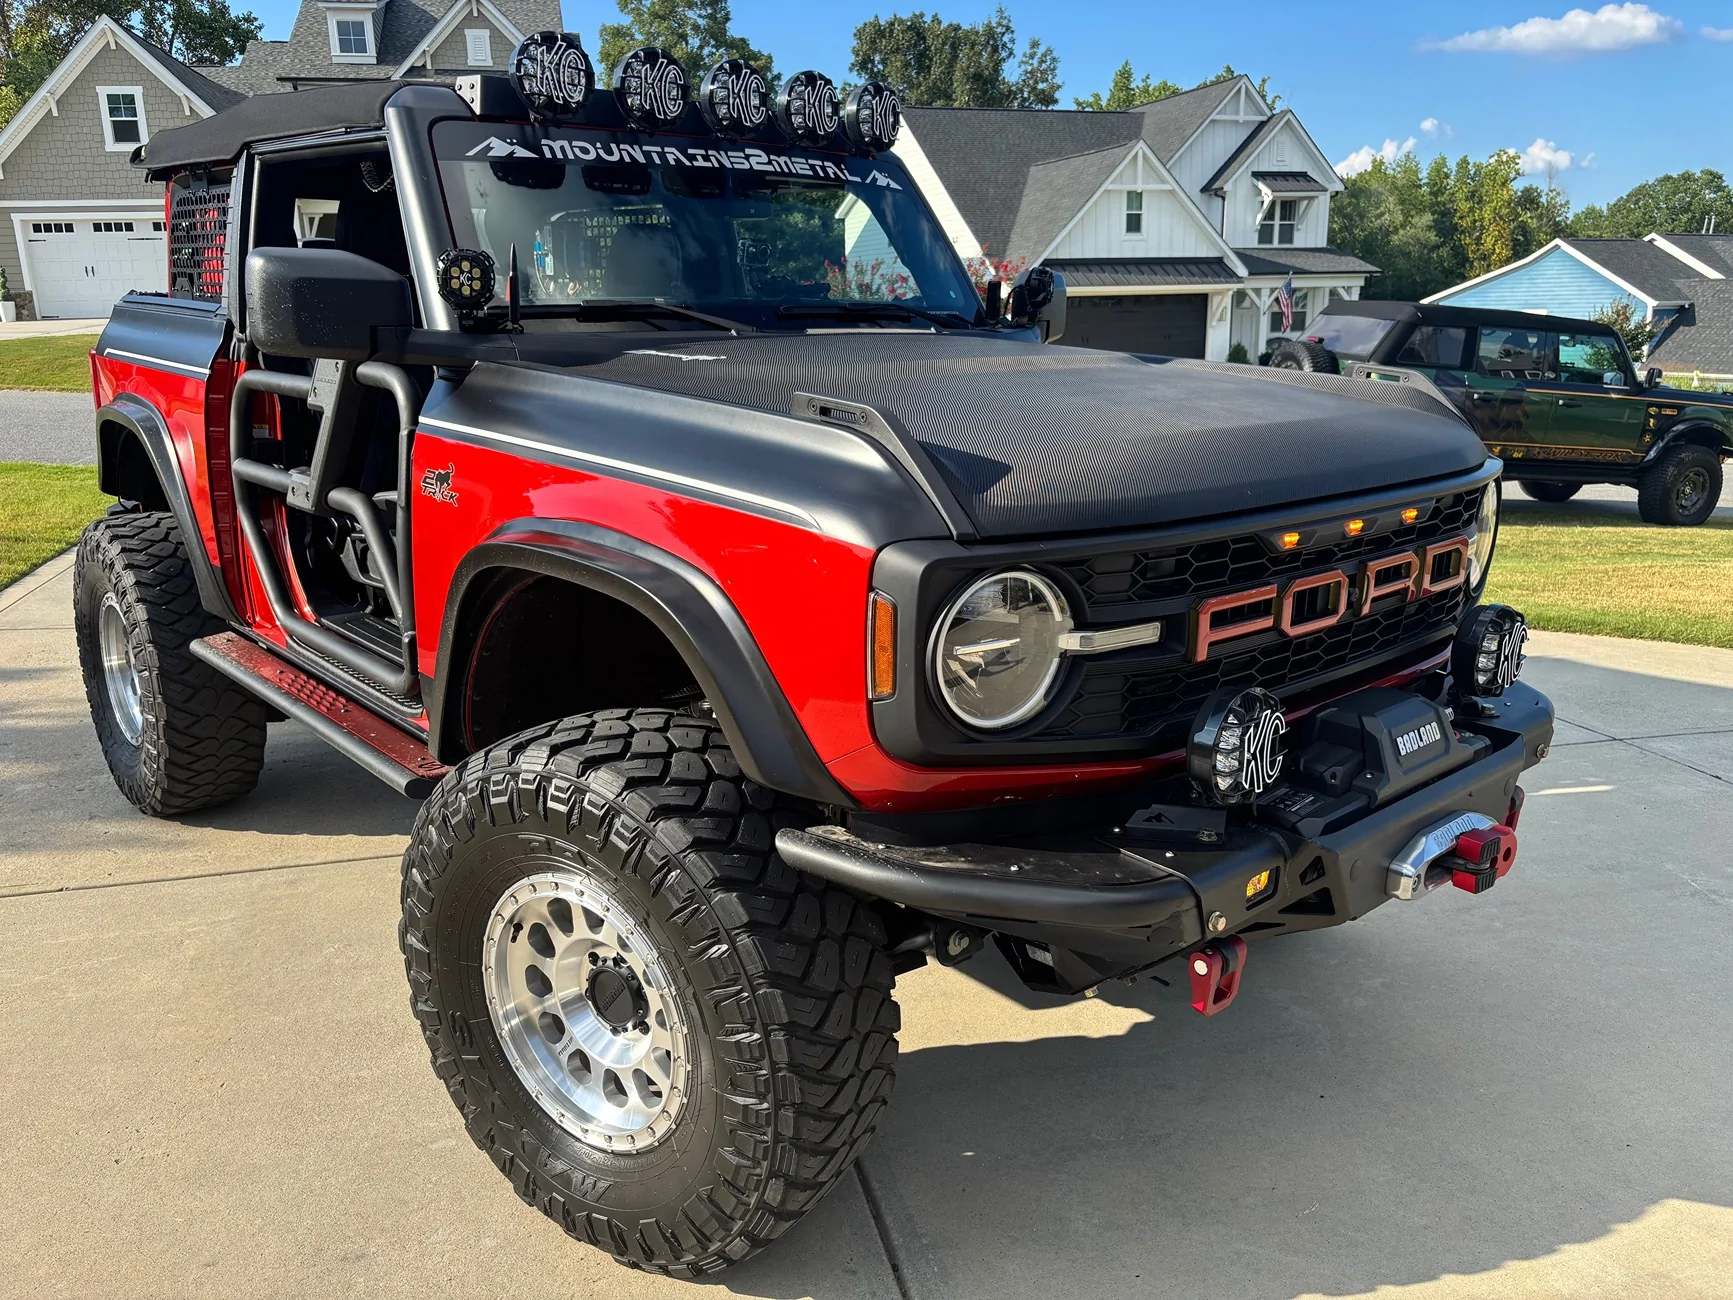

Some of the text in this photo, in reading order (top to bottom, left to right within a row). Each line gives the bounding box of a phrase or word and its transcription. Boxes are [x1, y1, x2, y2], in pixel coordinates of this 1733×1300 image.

[537, 42, 586, 103] KC
[641, 59, 683, 119] KC
[729, 69, 766, 126] KC
[805, 81, 839, 135] KC
[872, 91, 900, 142] KC
[460, 272, 472, 286] KC
[1193, 535, 1470, 663] FORD
[1498, 622, 1528, 687] KC
[1242, 709, 1286, 793] KC
[1396, 721, 1441, 756] BADLAND
